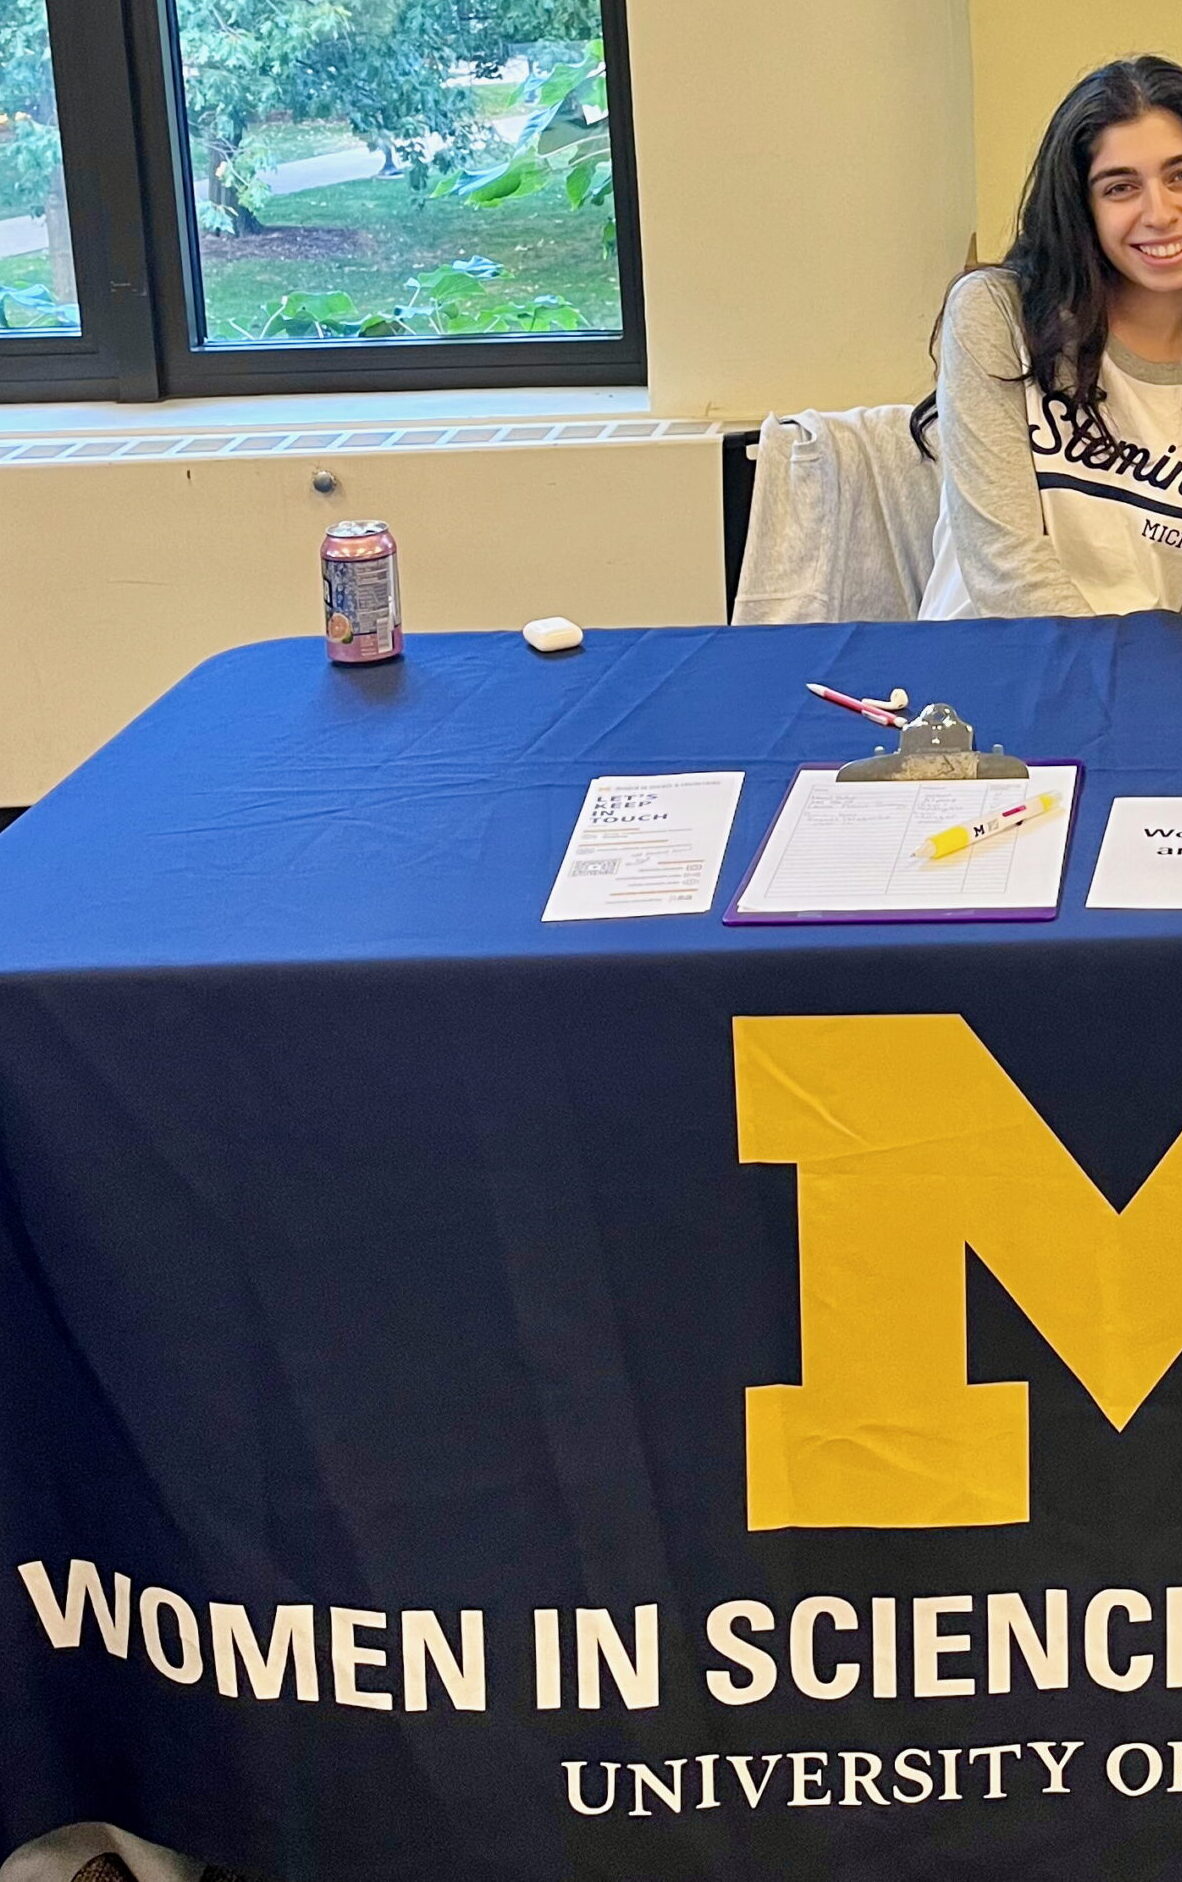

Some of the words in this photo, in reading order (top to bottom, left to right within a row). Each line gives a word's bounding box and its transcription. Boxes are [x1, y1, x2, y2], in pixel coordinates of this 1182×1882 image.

[597, 793, 658, 802] LET'S
[594, 801, 652, 809] KEEP
[590, 813, 668, 824] TOUCH
[17, 1559, 486, 1711] WOMEN
[534, 1603, 660, 1709] IN
[561, 1740, 1084, 1816] UNIVERSITY
